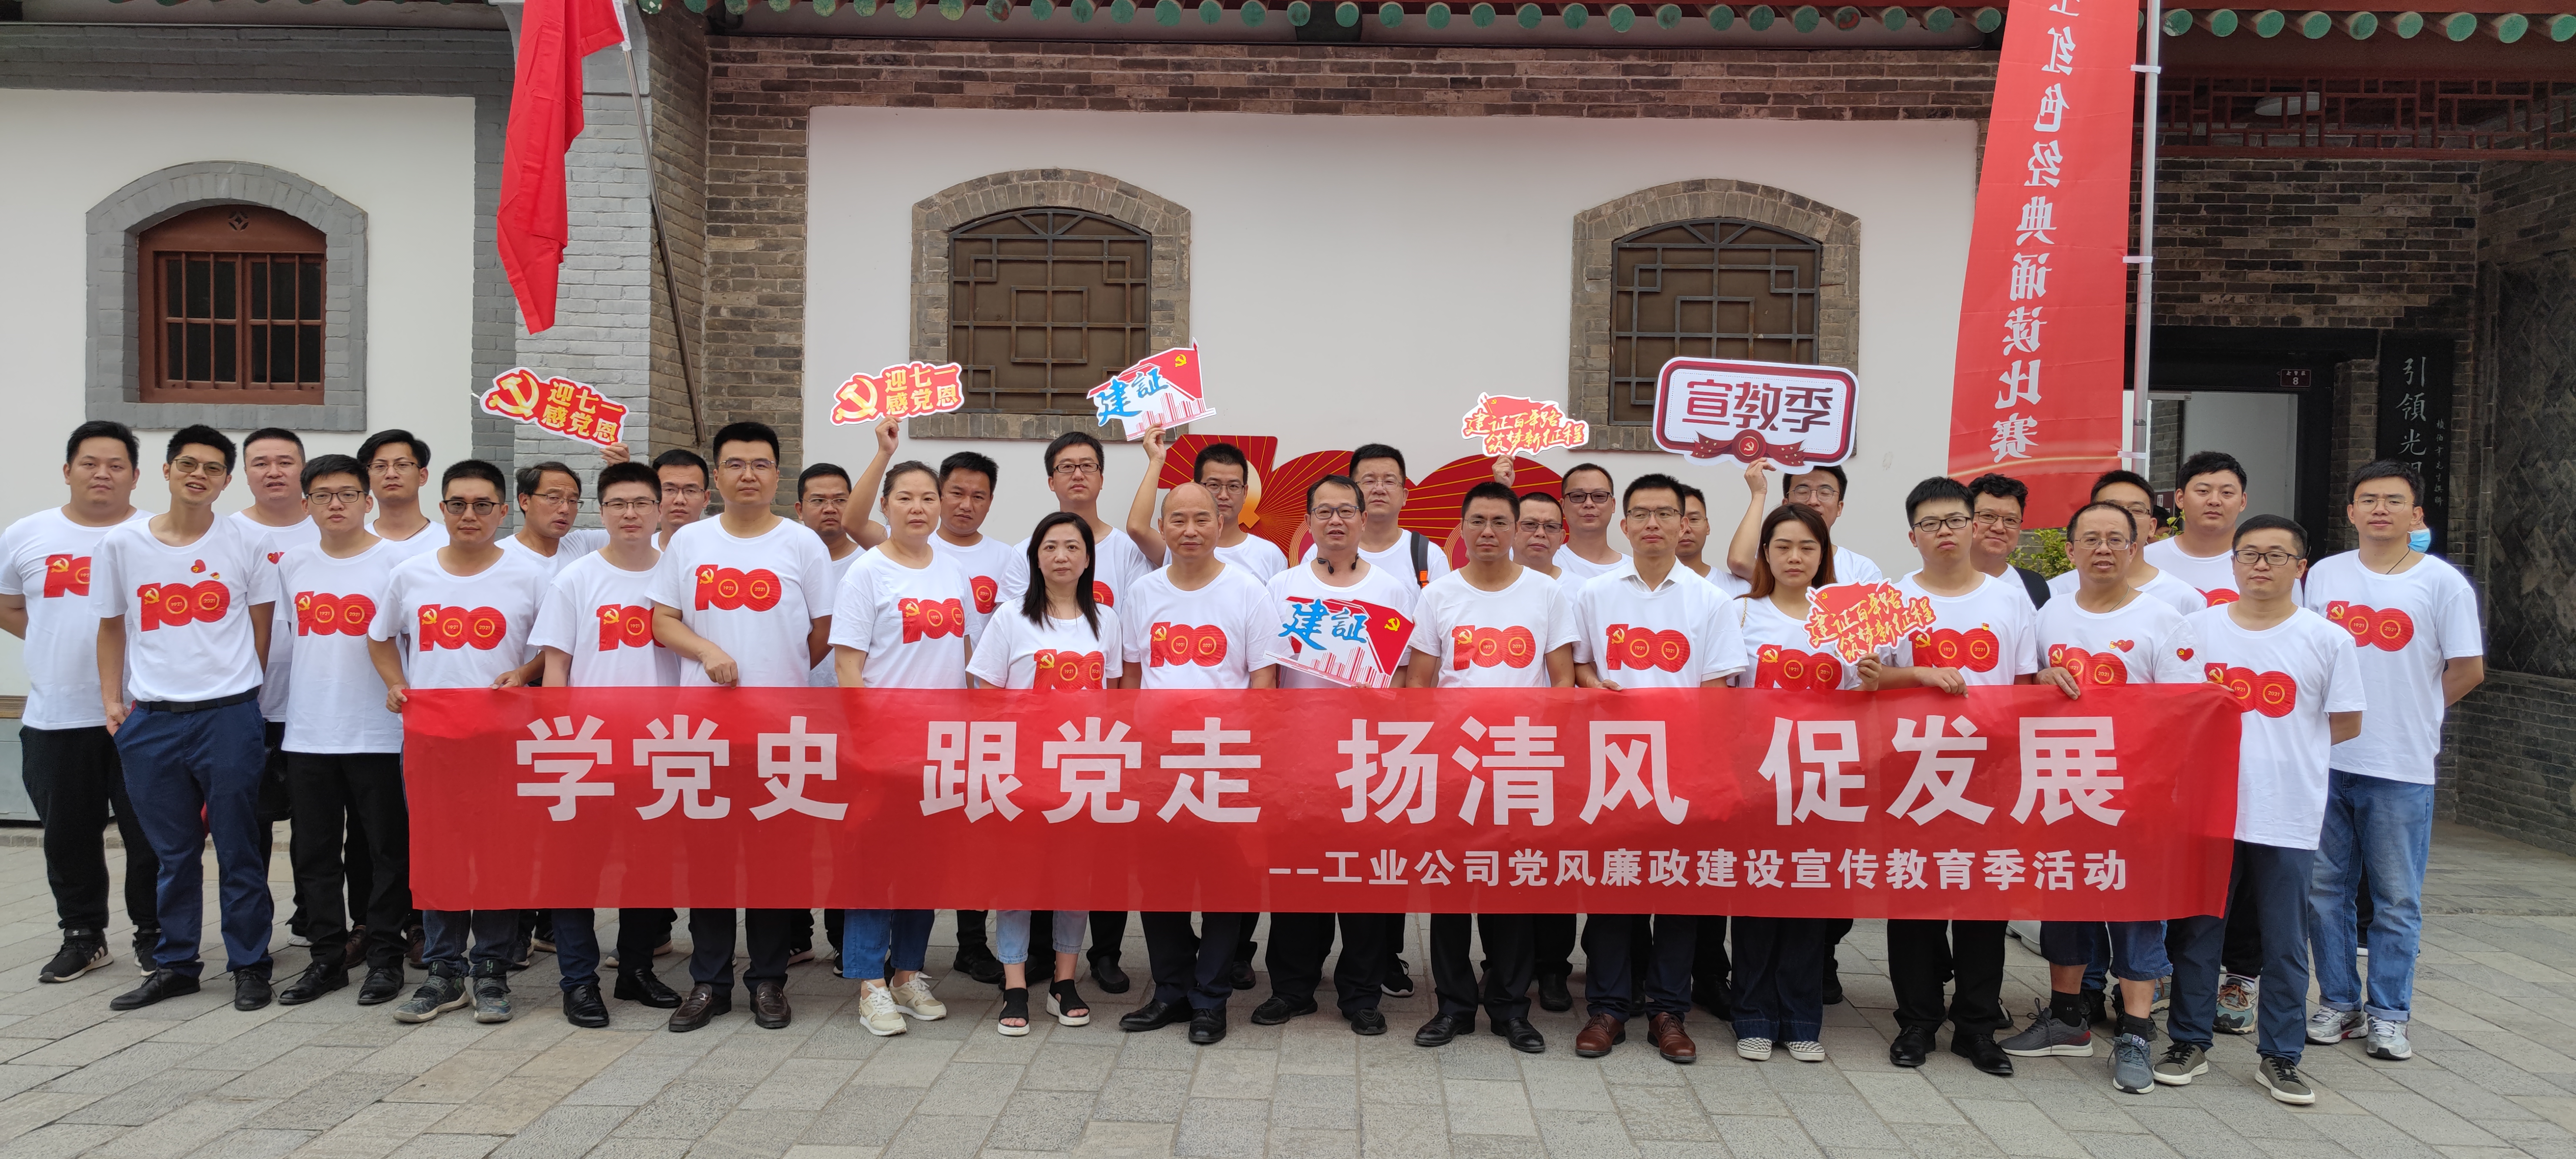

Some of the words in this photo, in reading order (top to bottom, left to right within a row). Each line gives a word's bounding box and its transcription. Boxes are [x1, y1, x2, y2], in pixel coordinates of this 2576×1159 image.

[547, 381, 624, 414] 迎七一
[885, 366, 956, 393] 迎七一
[886, 384, 959, 415] 感党恩
[2293, 377, 2299, 385] 8
[541, 404, 617, 442] 感党恩
[1466, 409, 1561, 434] 建证百年路
[1682, 379, 1833, 433] 宣教季
[1486, 423, 1583, 455] 筑梦新征程
[137, 580, 230, 632] 100
[695, 564, 782, 611] 100
[294, 591, 377, 636] 100
[418, 604, 506, 651] 100
[1807, 588, 1901, 645] 建证百年路
[1840, 598, 1934, 661] 筑梦新征程
[1150, 622, 1227, 668] 100
[1452, 625, 1536, 671] 100
[1606, 624, 1690, 673] 100
[517, 715, 848, 821] 学党史
[919, 717, 1261, 823] 跟党走
[1335, 716, 1689, 826] 扬清风
[1758, 715, 2125, 826] 促发展
